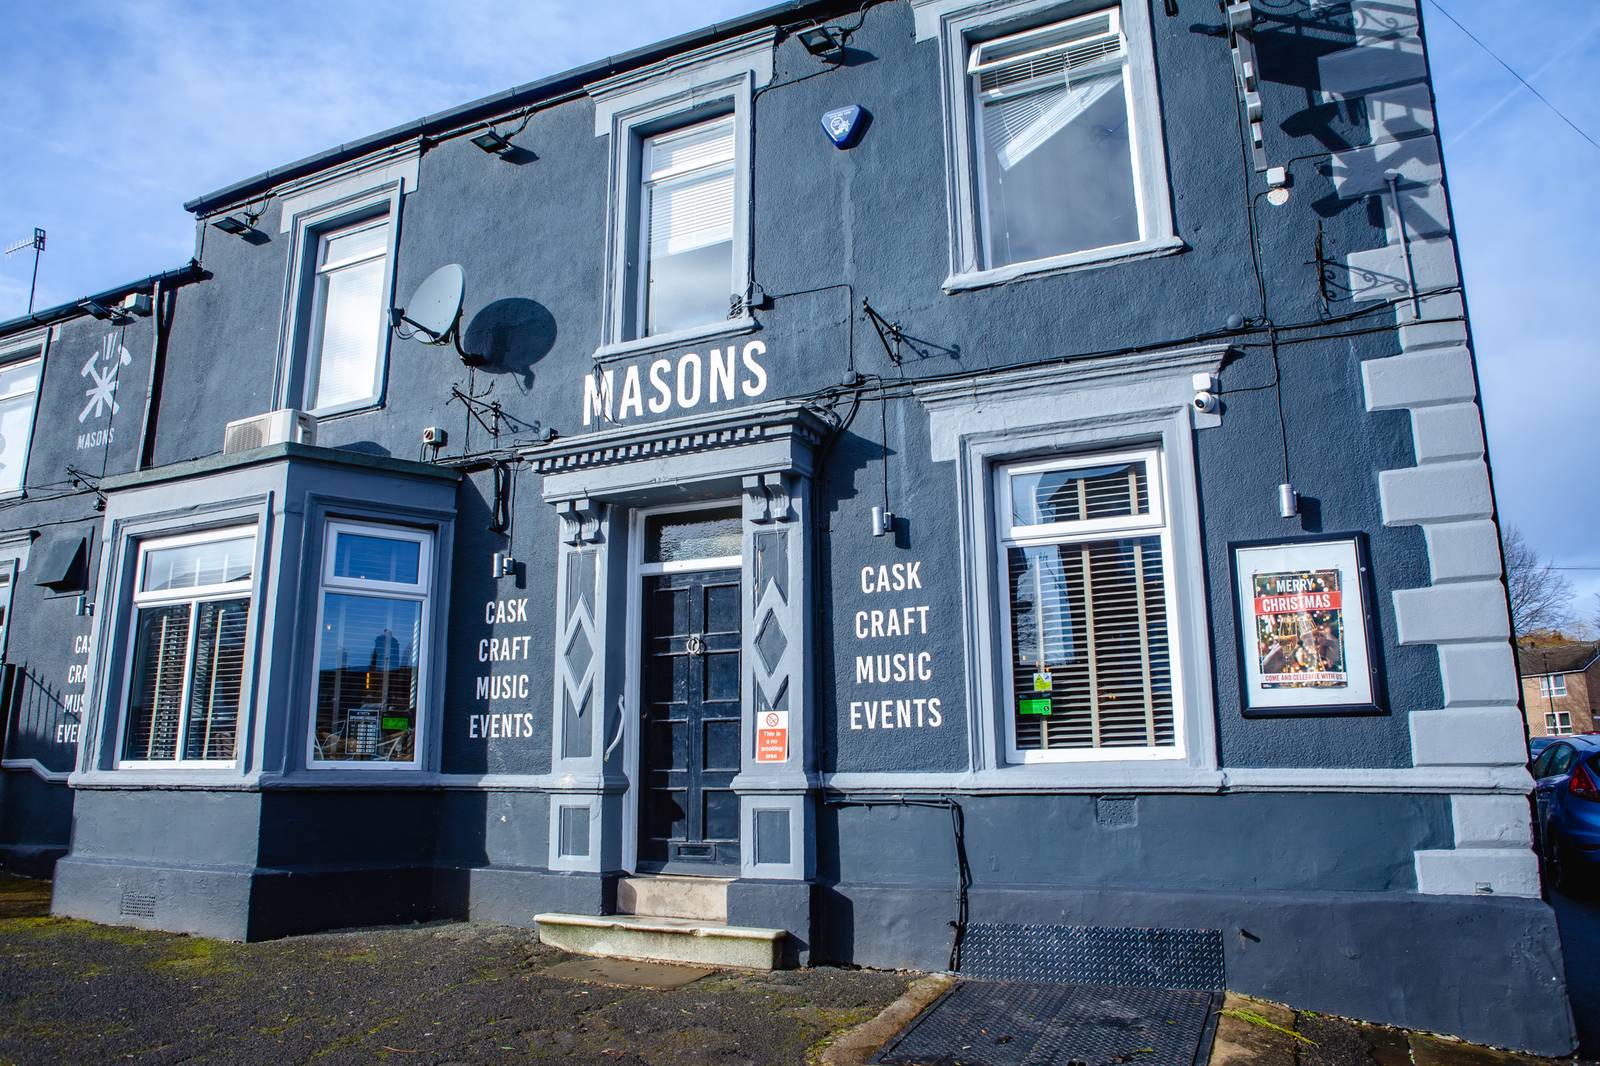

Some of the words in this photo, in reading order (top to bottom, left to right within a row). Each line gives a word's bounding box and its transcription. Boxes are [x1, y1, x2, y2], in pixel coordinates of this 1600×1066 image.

[583, 340, 767, 426] MASONS
[77, 428, 115, 450] MASONS
[861, 561, 922, 594] CASK
[1276, 578, 1314, 593] MERRY
[485, 598, 528, 625] CASK
[1262, 594, 1331, 612] CHRISTMAS
[855, 606, 930, 639] CRAFT
[478, 635, 531, 663] CRAFT
[856, 651, 932, 684] MUSIC
[476, 674, 529, 700] MUSIC
[469, 712, 533, 739] EVENTS
[850, 697, 943, 730] EVENTS
